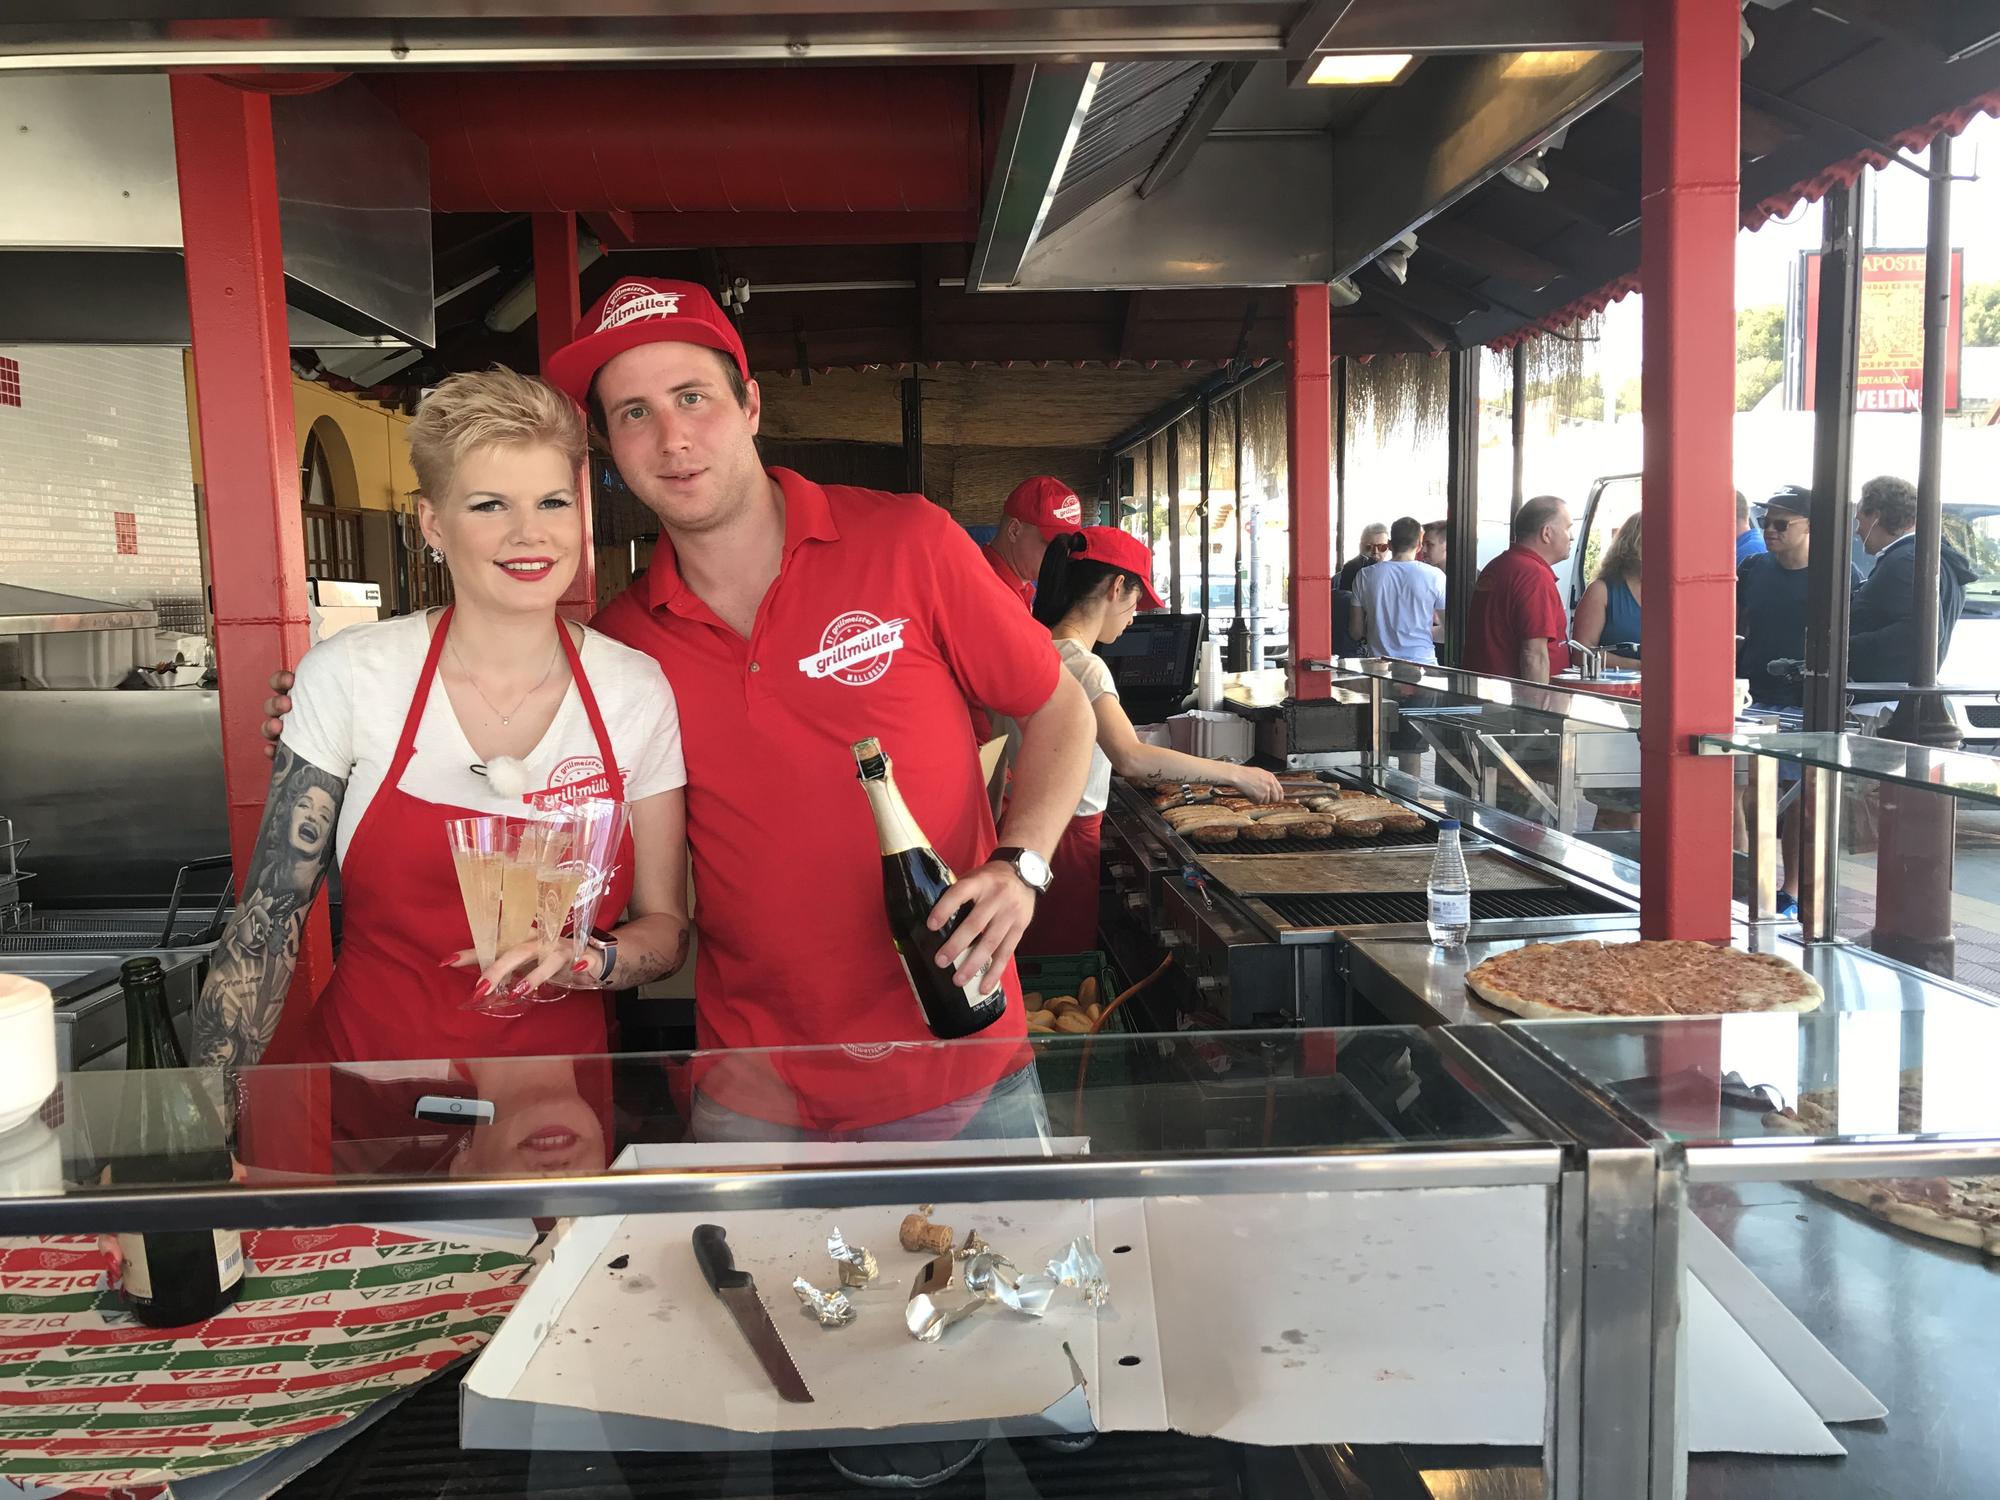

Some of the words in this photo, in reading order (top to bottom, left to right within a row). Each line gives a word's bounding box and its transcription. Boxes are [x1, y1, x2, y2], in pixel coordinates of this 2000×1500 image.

[602, 298, 671, 331] rillmüller
[1857, 389, 1922, 409] VELTIN
[832, 615, 875, 635] grillmeister
[816, 631, 896, 673] grillmüller
[561, 760, 603, 774] grillmeister
[543, 778, 610, 808] grillmüll
